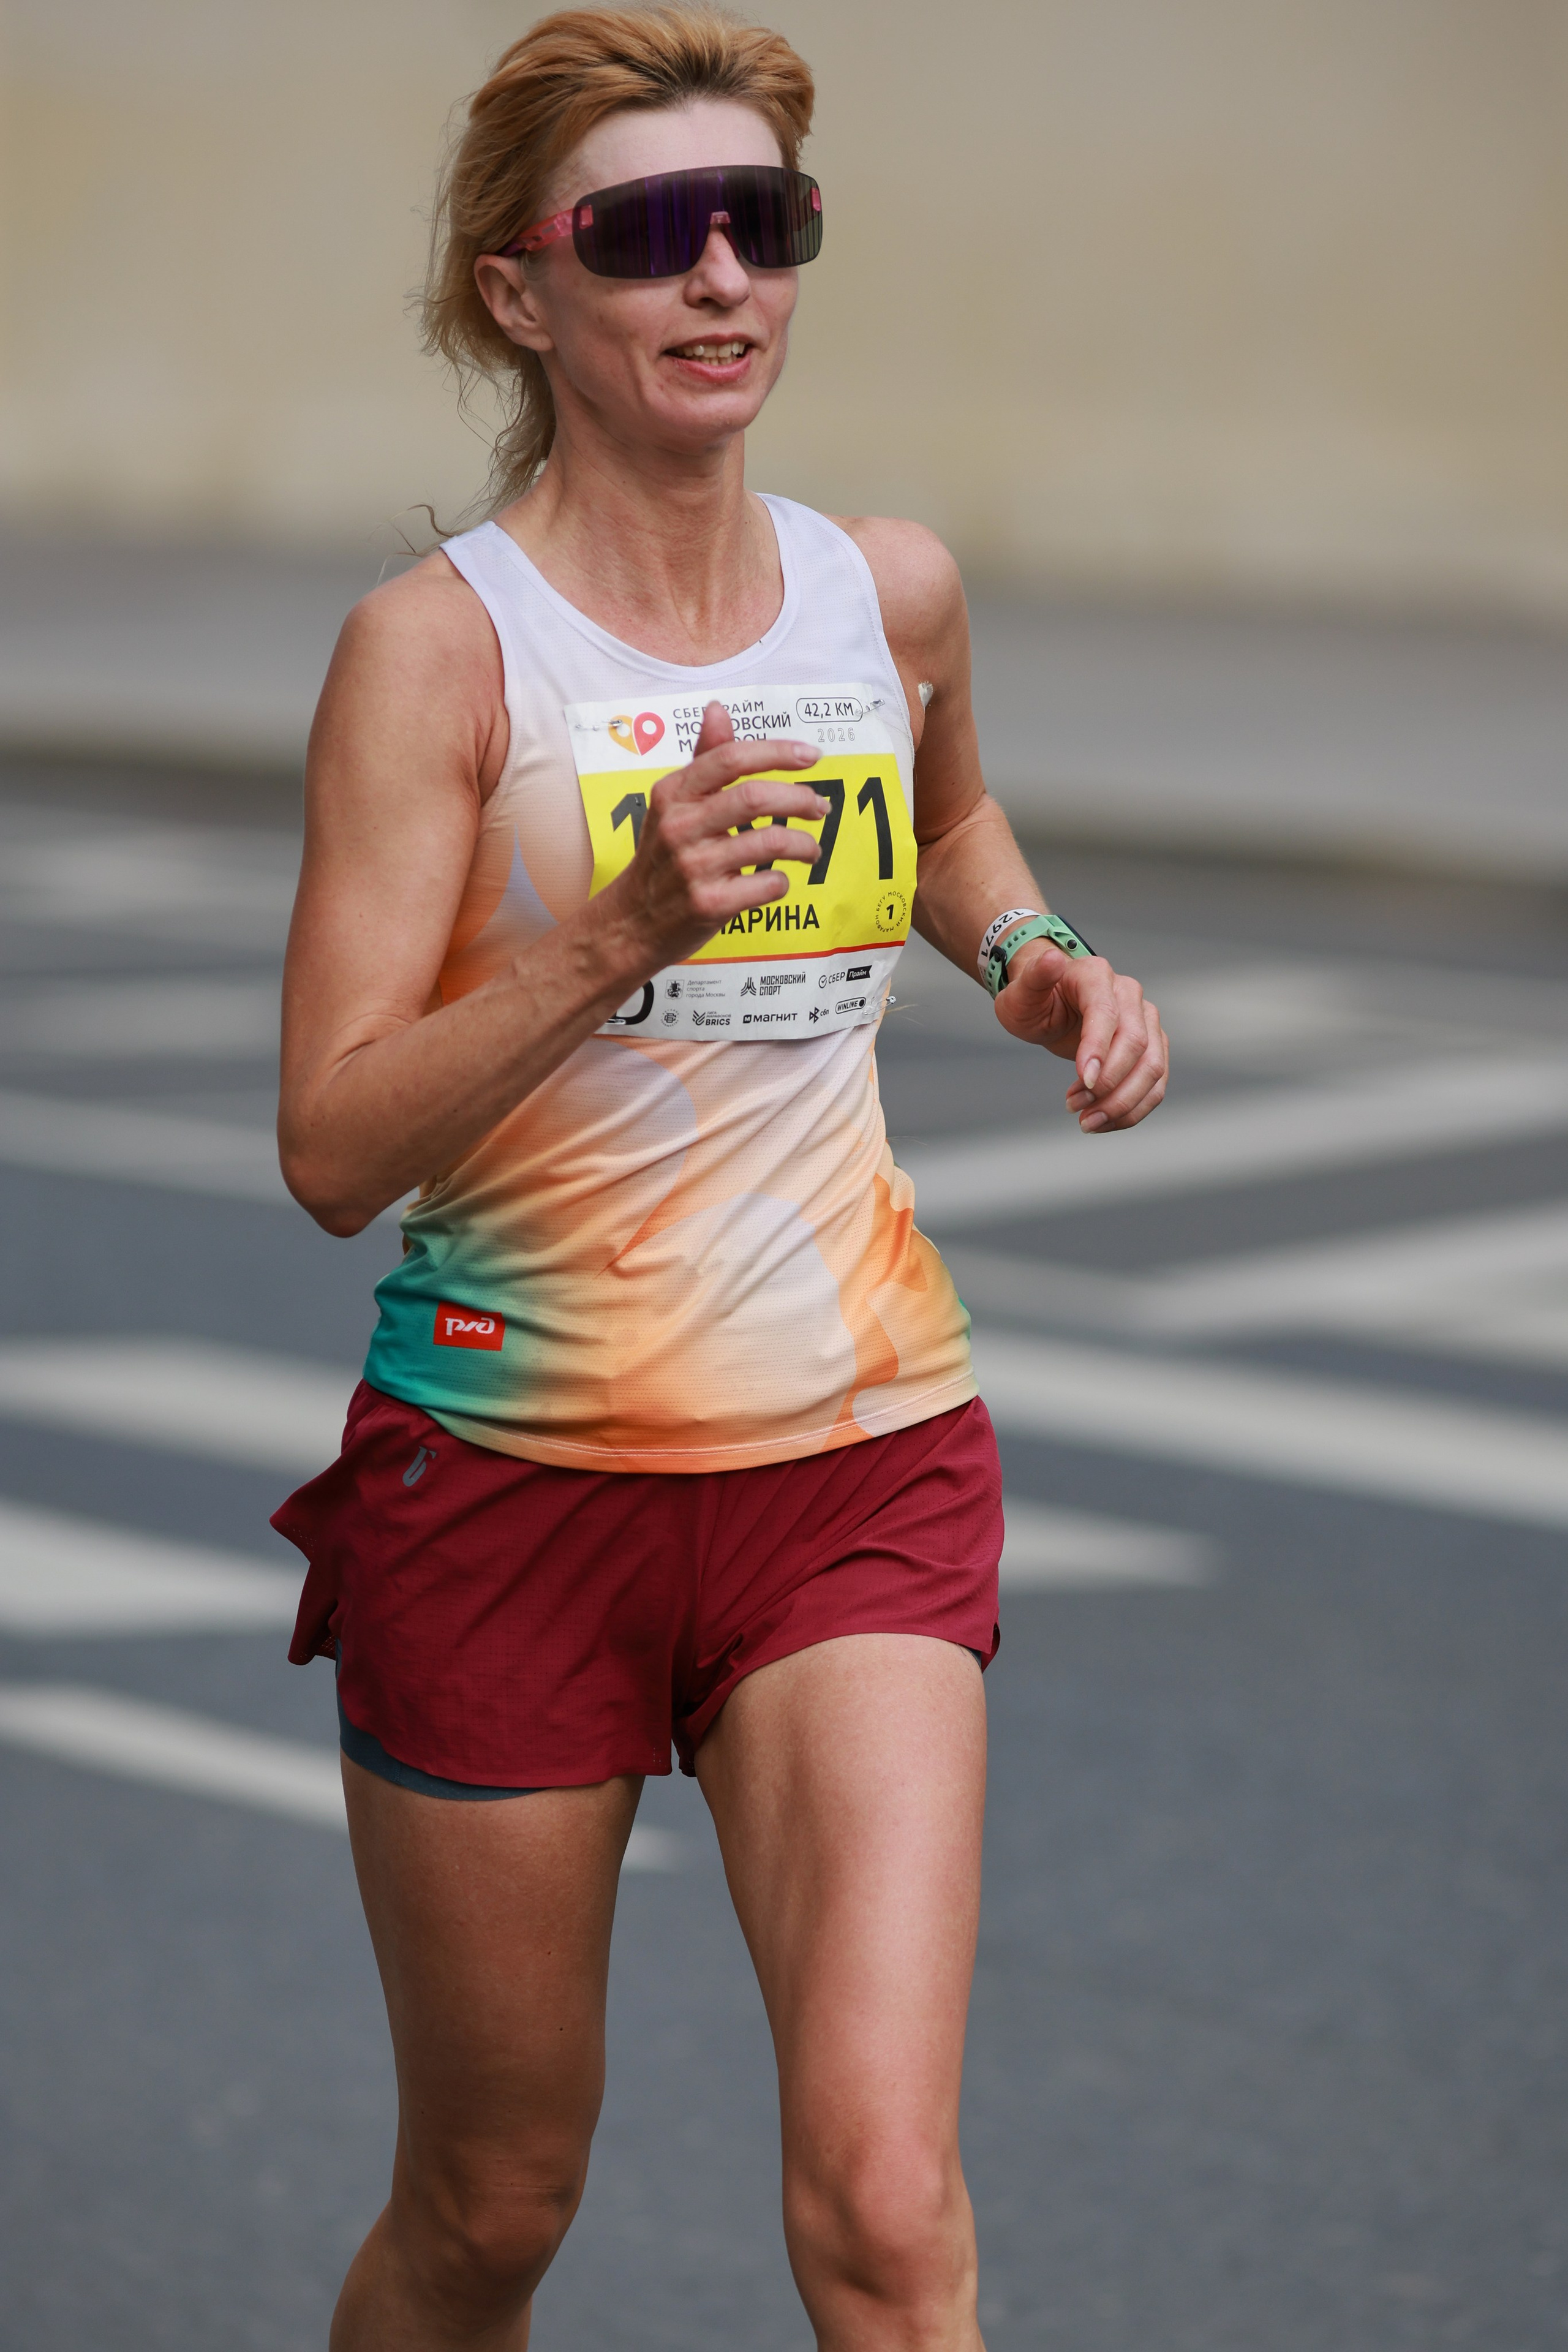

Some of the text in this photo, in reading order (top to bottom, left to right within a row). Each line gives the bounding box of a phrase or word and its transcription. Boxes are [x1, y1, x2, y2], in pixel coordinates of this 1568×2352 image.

[804, 703, 831, 718] 42,2
[676, 712, 791, 736] МООВСКИЙ
[817, 727, 856, 743] 2026
[611, 777, 894, 885] 171
[876, 895, 886, 911] БЕГУ
[886, 903, 894, 920] 1
[981, 910, 1024, 957] 12971
[760, 971, 806, 986] МОСКОВСКИЙ
[828, 969, 867, 984] СБЕР Прайм
[760, 986, 782, 996] СПОРТ
[837, 1000, 859, 1011] WINLINE
[753, 1013, 798, 1022] магнит
